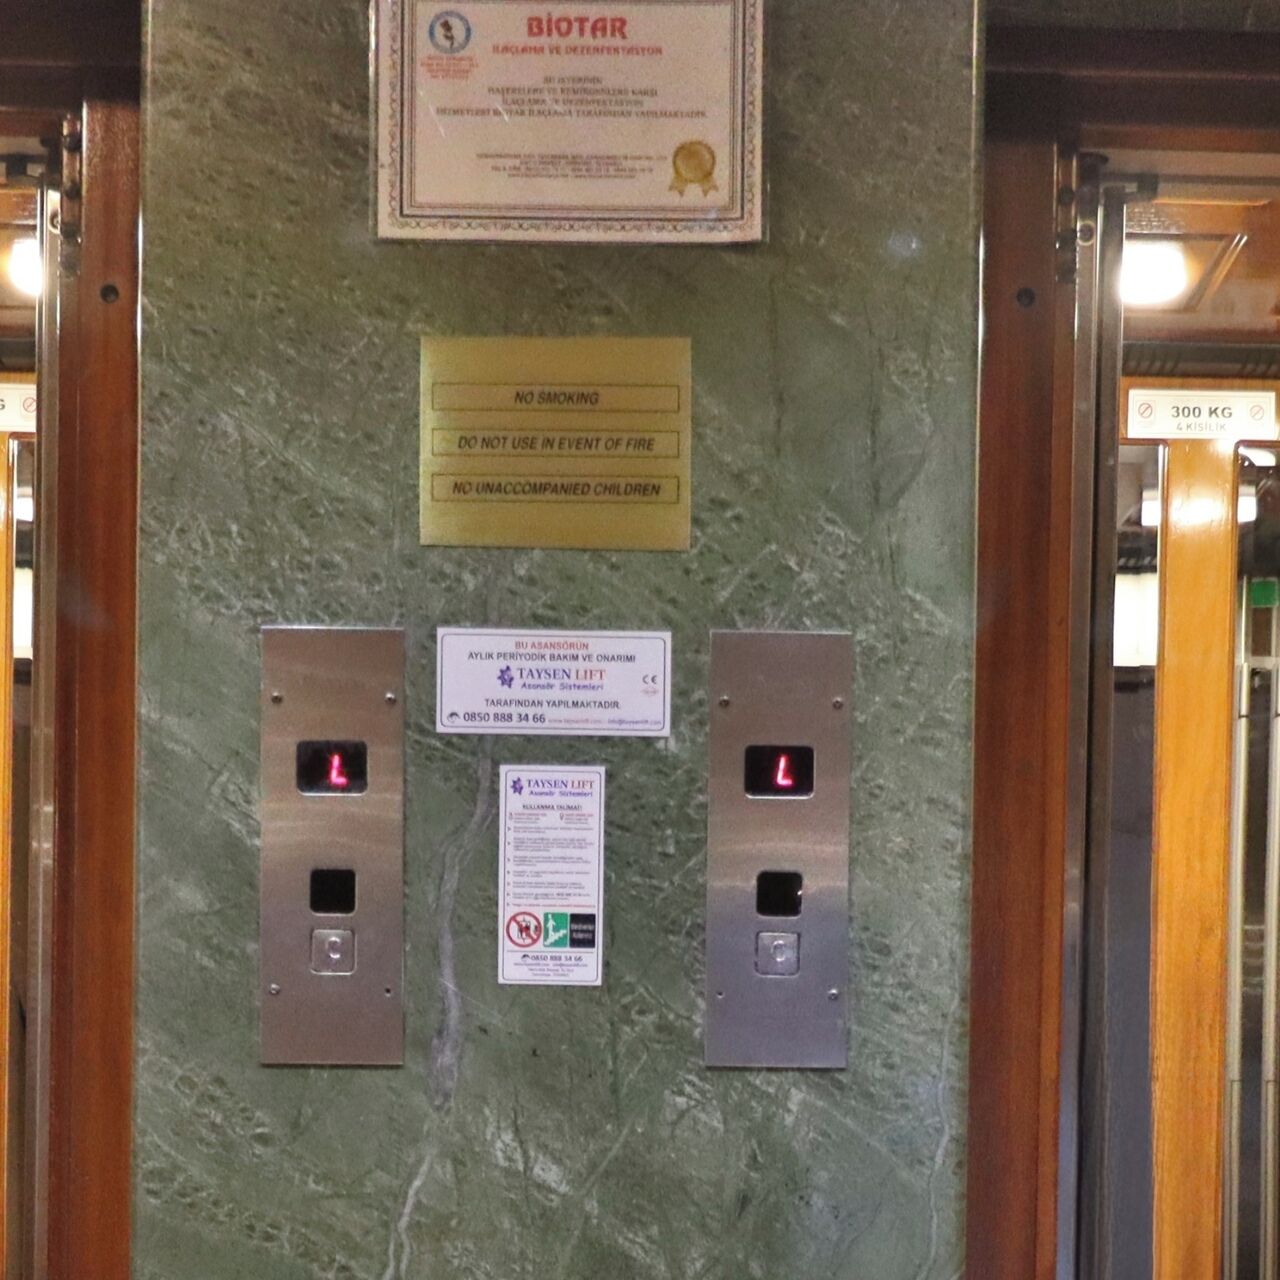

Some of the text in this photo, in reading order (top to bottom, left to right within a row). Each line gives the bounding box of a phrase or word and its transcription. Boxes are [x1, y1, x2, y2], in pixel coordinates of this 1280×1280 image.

[526, 12, 629, 40] BİOTAR
[513, 390, 600, 406] NO SMOKING
[1171, 405, 1233, 419] 300 KG
[457, 435, 656, 452] DO NOT USE IN EVENT OF FIRE
[452, 481, 662, 497] NO UNACCOMPANIED CHILDREN
[514, 641, 528, 650] BU
[467, 651, 637, 664] AYLIK PERİYODİK BAKIM VE ONARIMI
[517, 668, 607, 681] TAYSEN LIFT
[521, 682, 605, 692] Asansör Sistemleri
[484, 698, 544, 708] TARAFINDAN
[462, 711, 547, 725] 0850 888 34 66
[330, 752, 348, 786] L
[776, 755, 793, 786] L
[527, 778, 595, 790] TAYSEN LIFT
